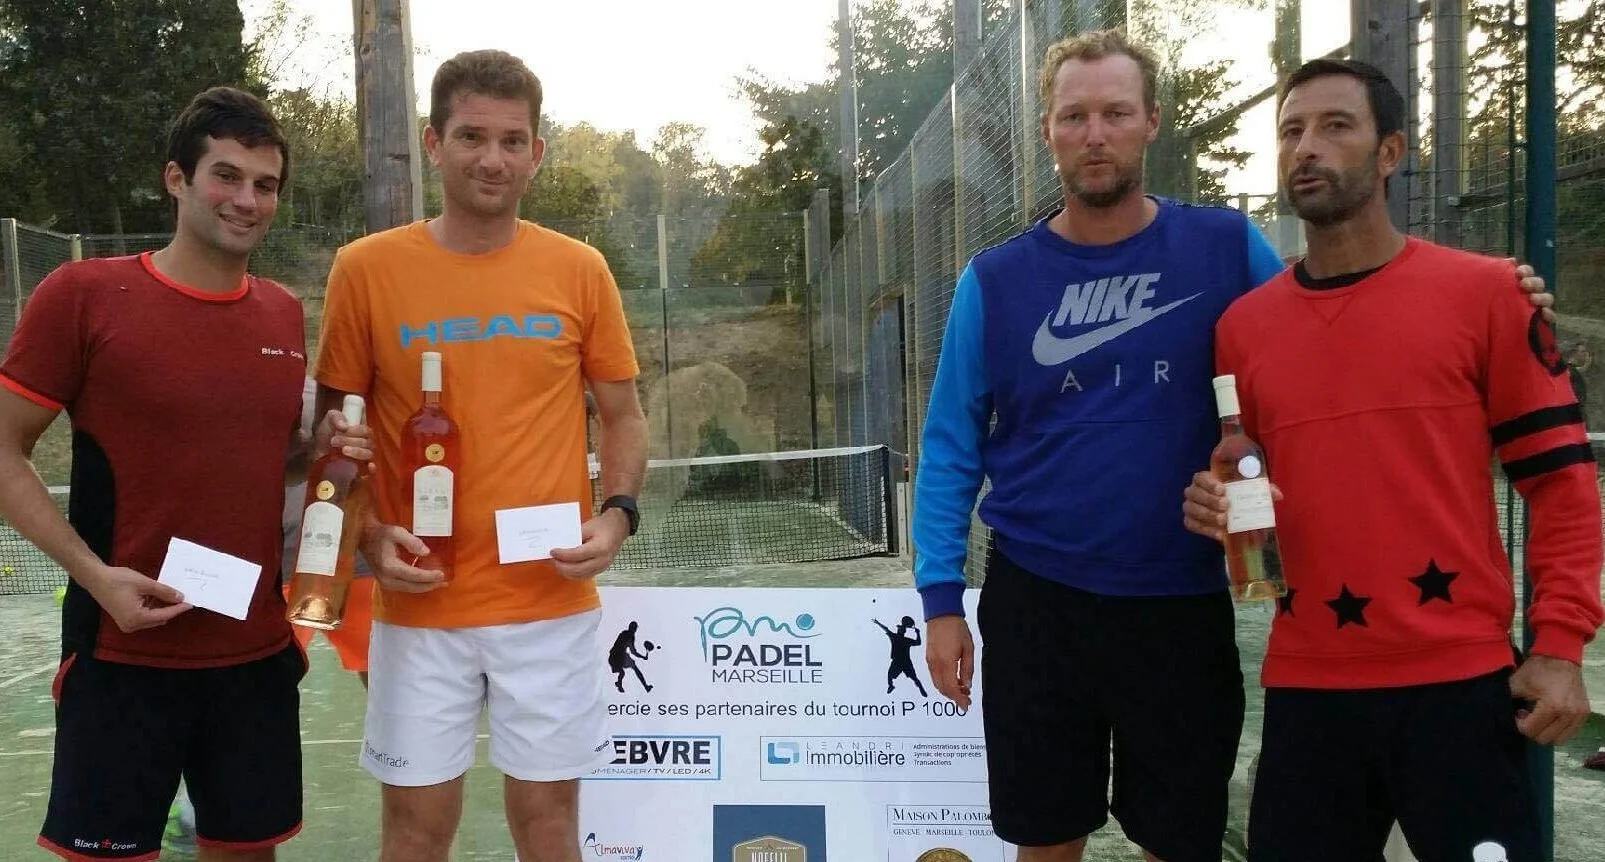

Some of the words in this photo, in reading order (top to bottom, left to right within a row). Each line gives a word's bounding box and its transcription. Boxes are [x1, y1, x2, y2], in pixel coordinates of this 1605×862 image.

[1052, 272, 1162, 327] NIKE
[400, 314, 564, 347] HEAD
[261, 347, 285, 355] Black
[1058, 360, 1171, 394] AIR
[711, 644, 823, 667] PADEL
[712, 669, 823, 683] MARSEILLE
[607, 700, 651, 716] ercie
[657, 704, 689, 716] ses
[695, 700, 798, 720] partenaires
[804, 701, 826, 717] du
[833, 701, 896, 717] tournoi
[901, 701, 916, 717] P
[805, 750, 906, 766] Immobilière
[893, 808, 938, 821] MAISON
[925, 828, 964, 836] MARSEILLE
[74, 838, 100, 849] Black
